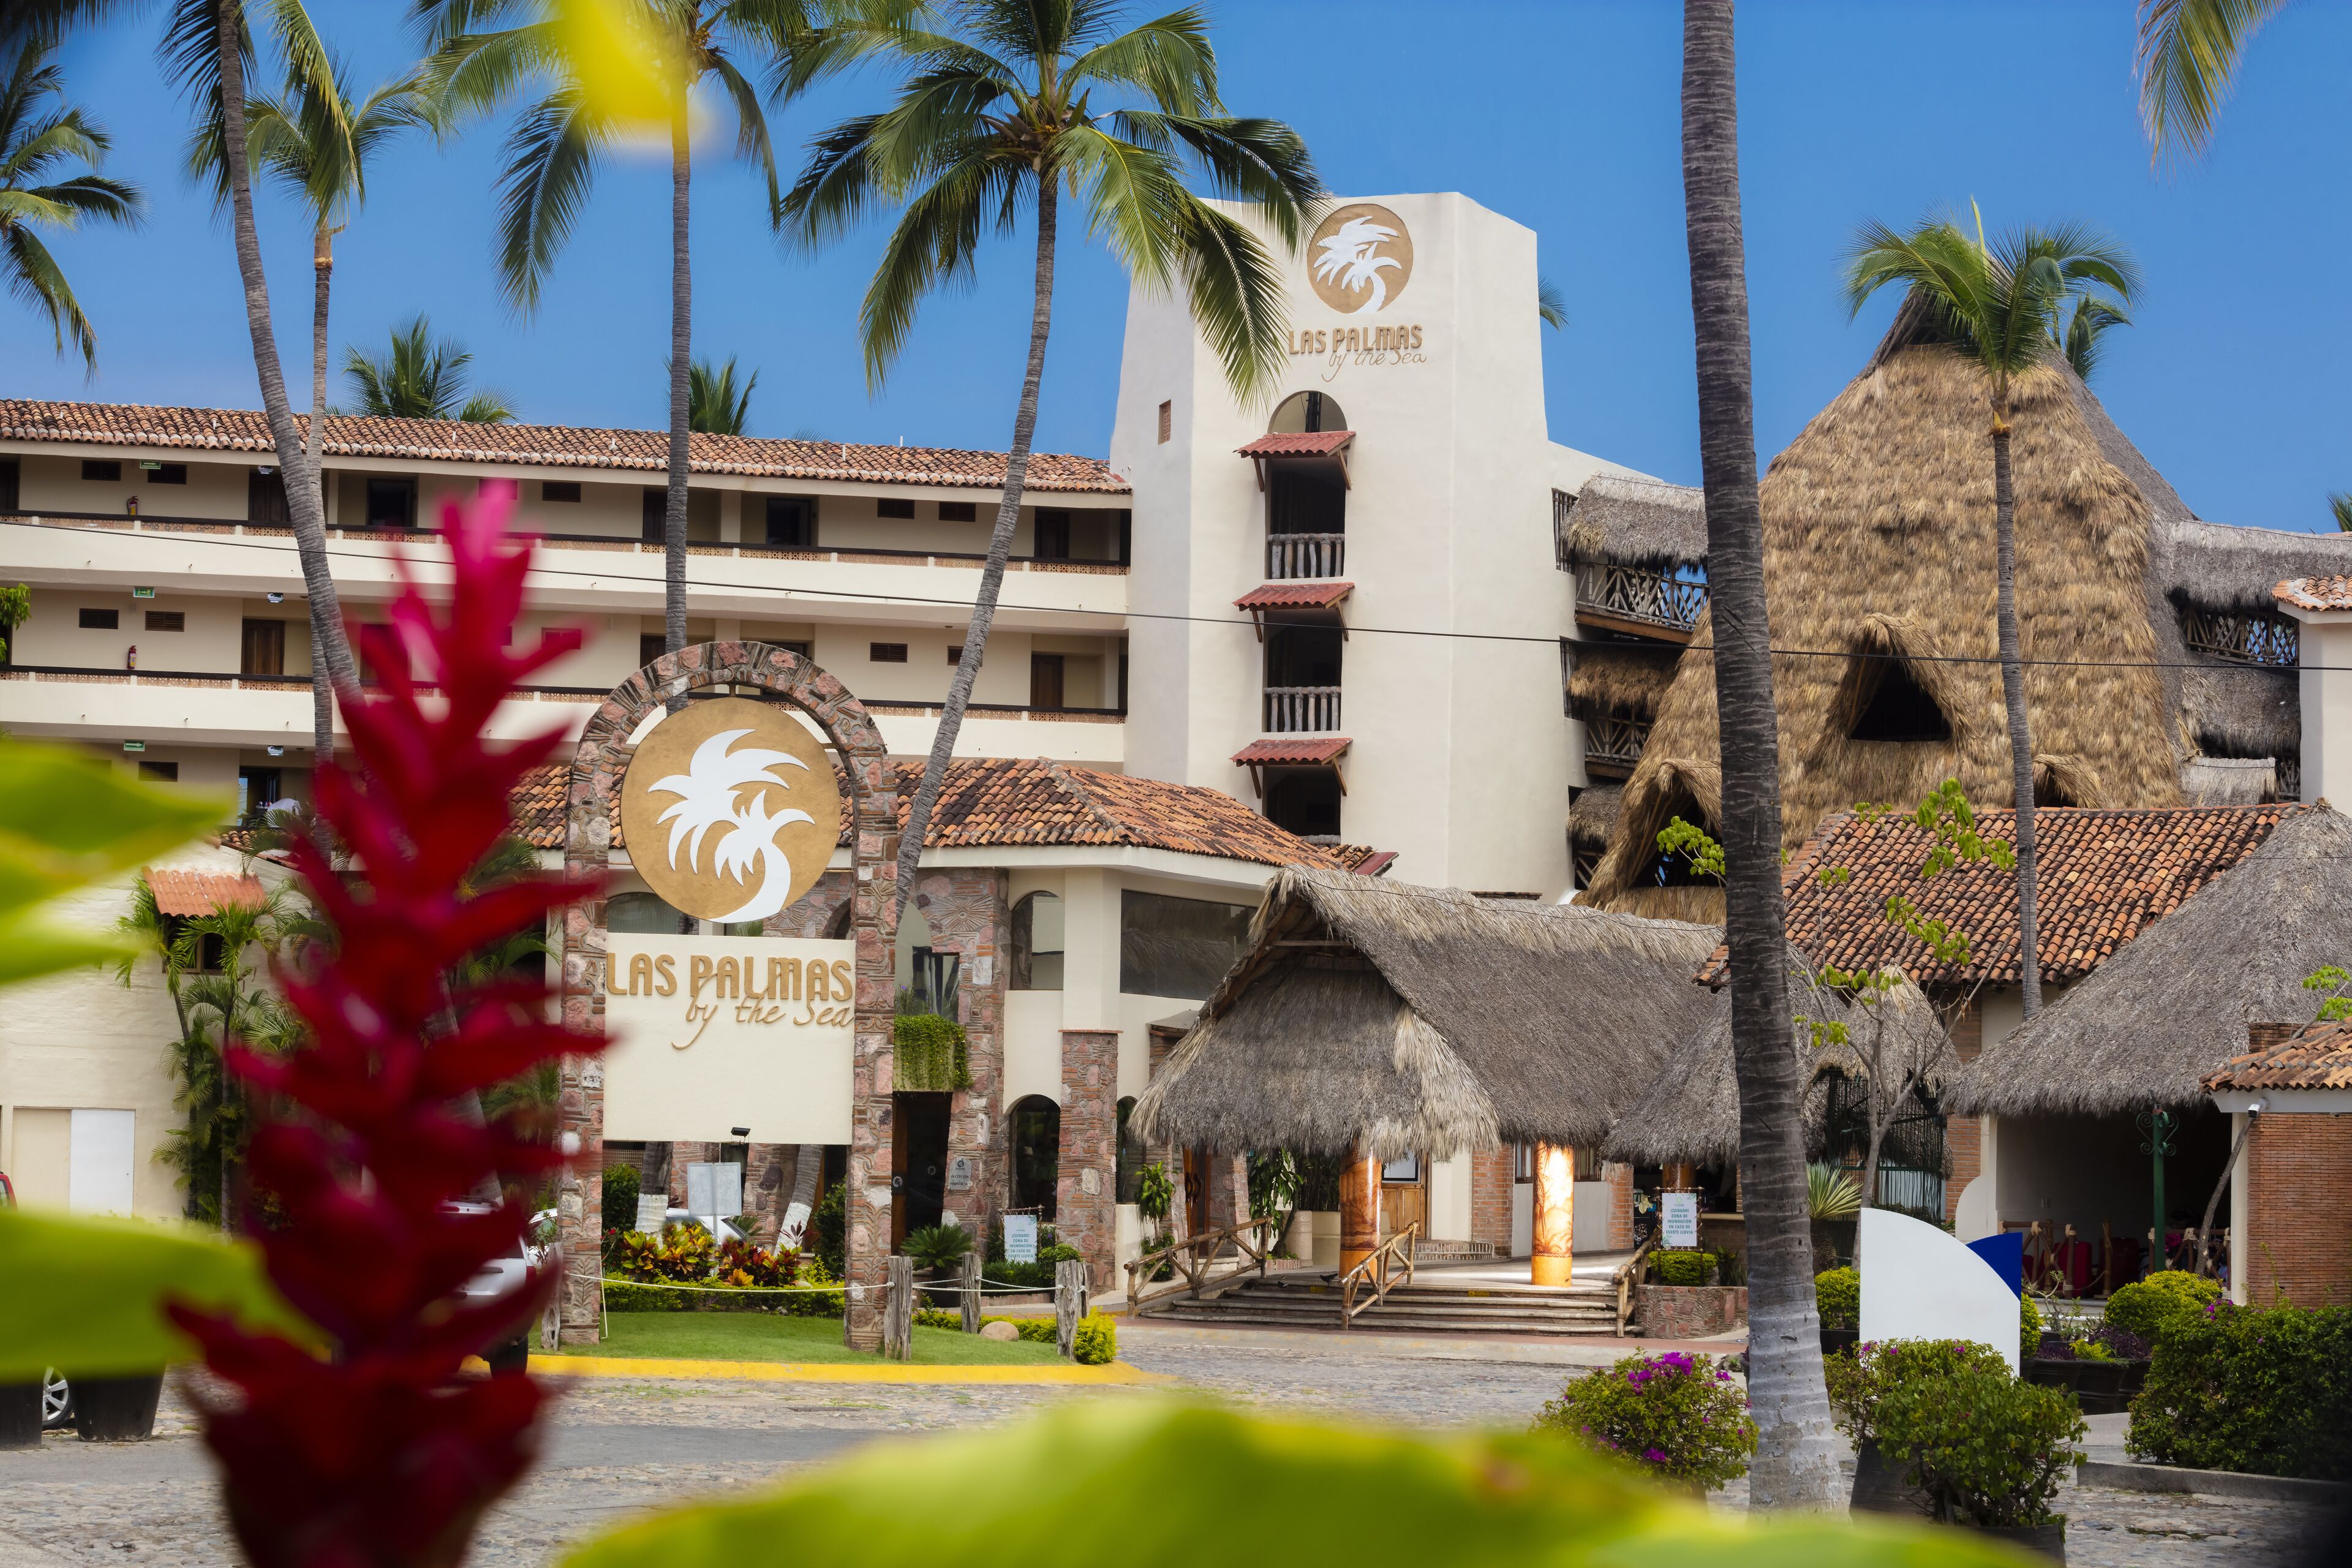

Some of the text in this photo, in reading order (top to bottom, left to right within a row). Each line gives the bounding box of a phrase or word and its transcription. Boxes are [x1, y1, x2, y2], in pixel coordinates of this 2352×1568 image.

[1289, 323, 1423, 354] LAS PALMAS
[1321, 337, 1427, 382] by the Sea
[606, 952, 853, 1001] LAS PALMAS
[671, 973, 854, 1050] by the Sea
